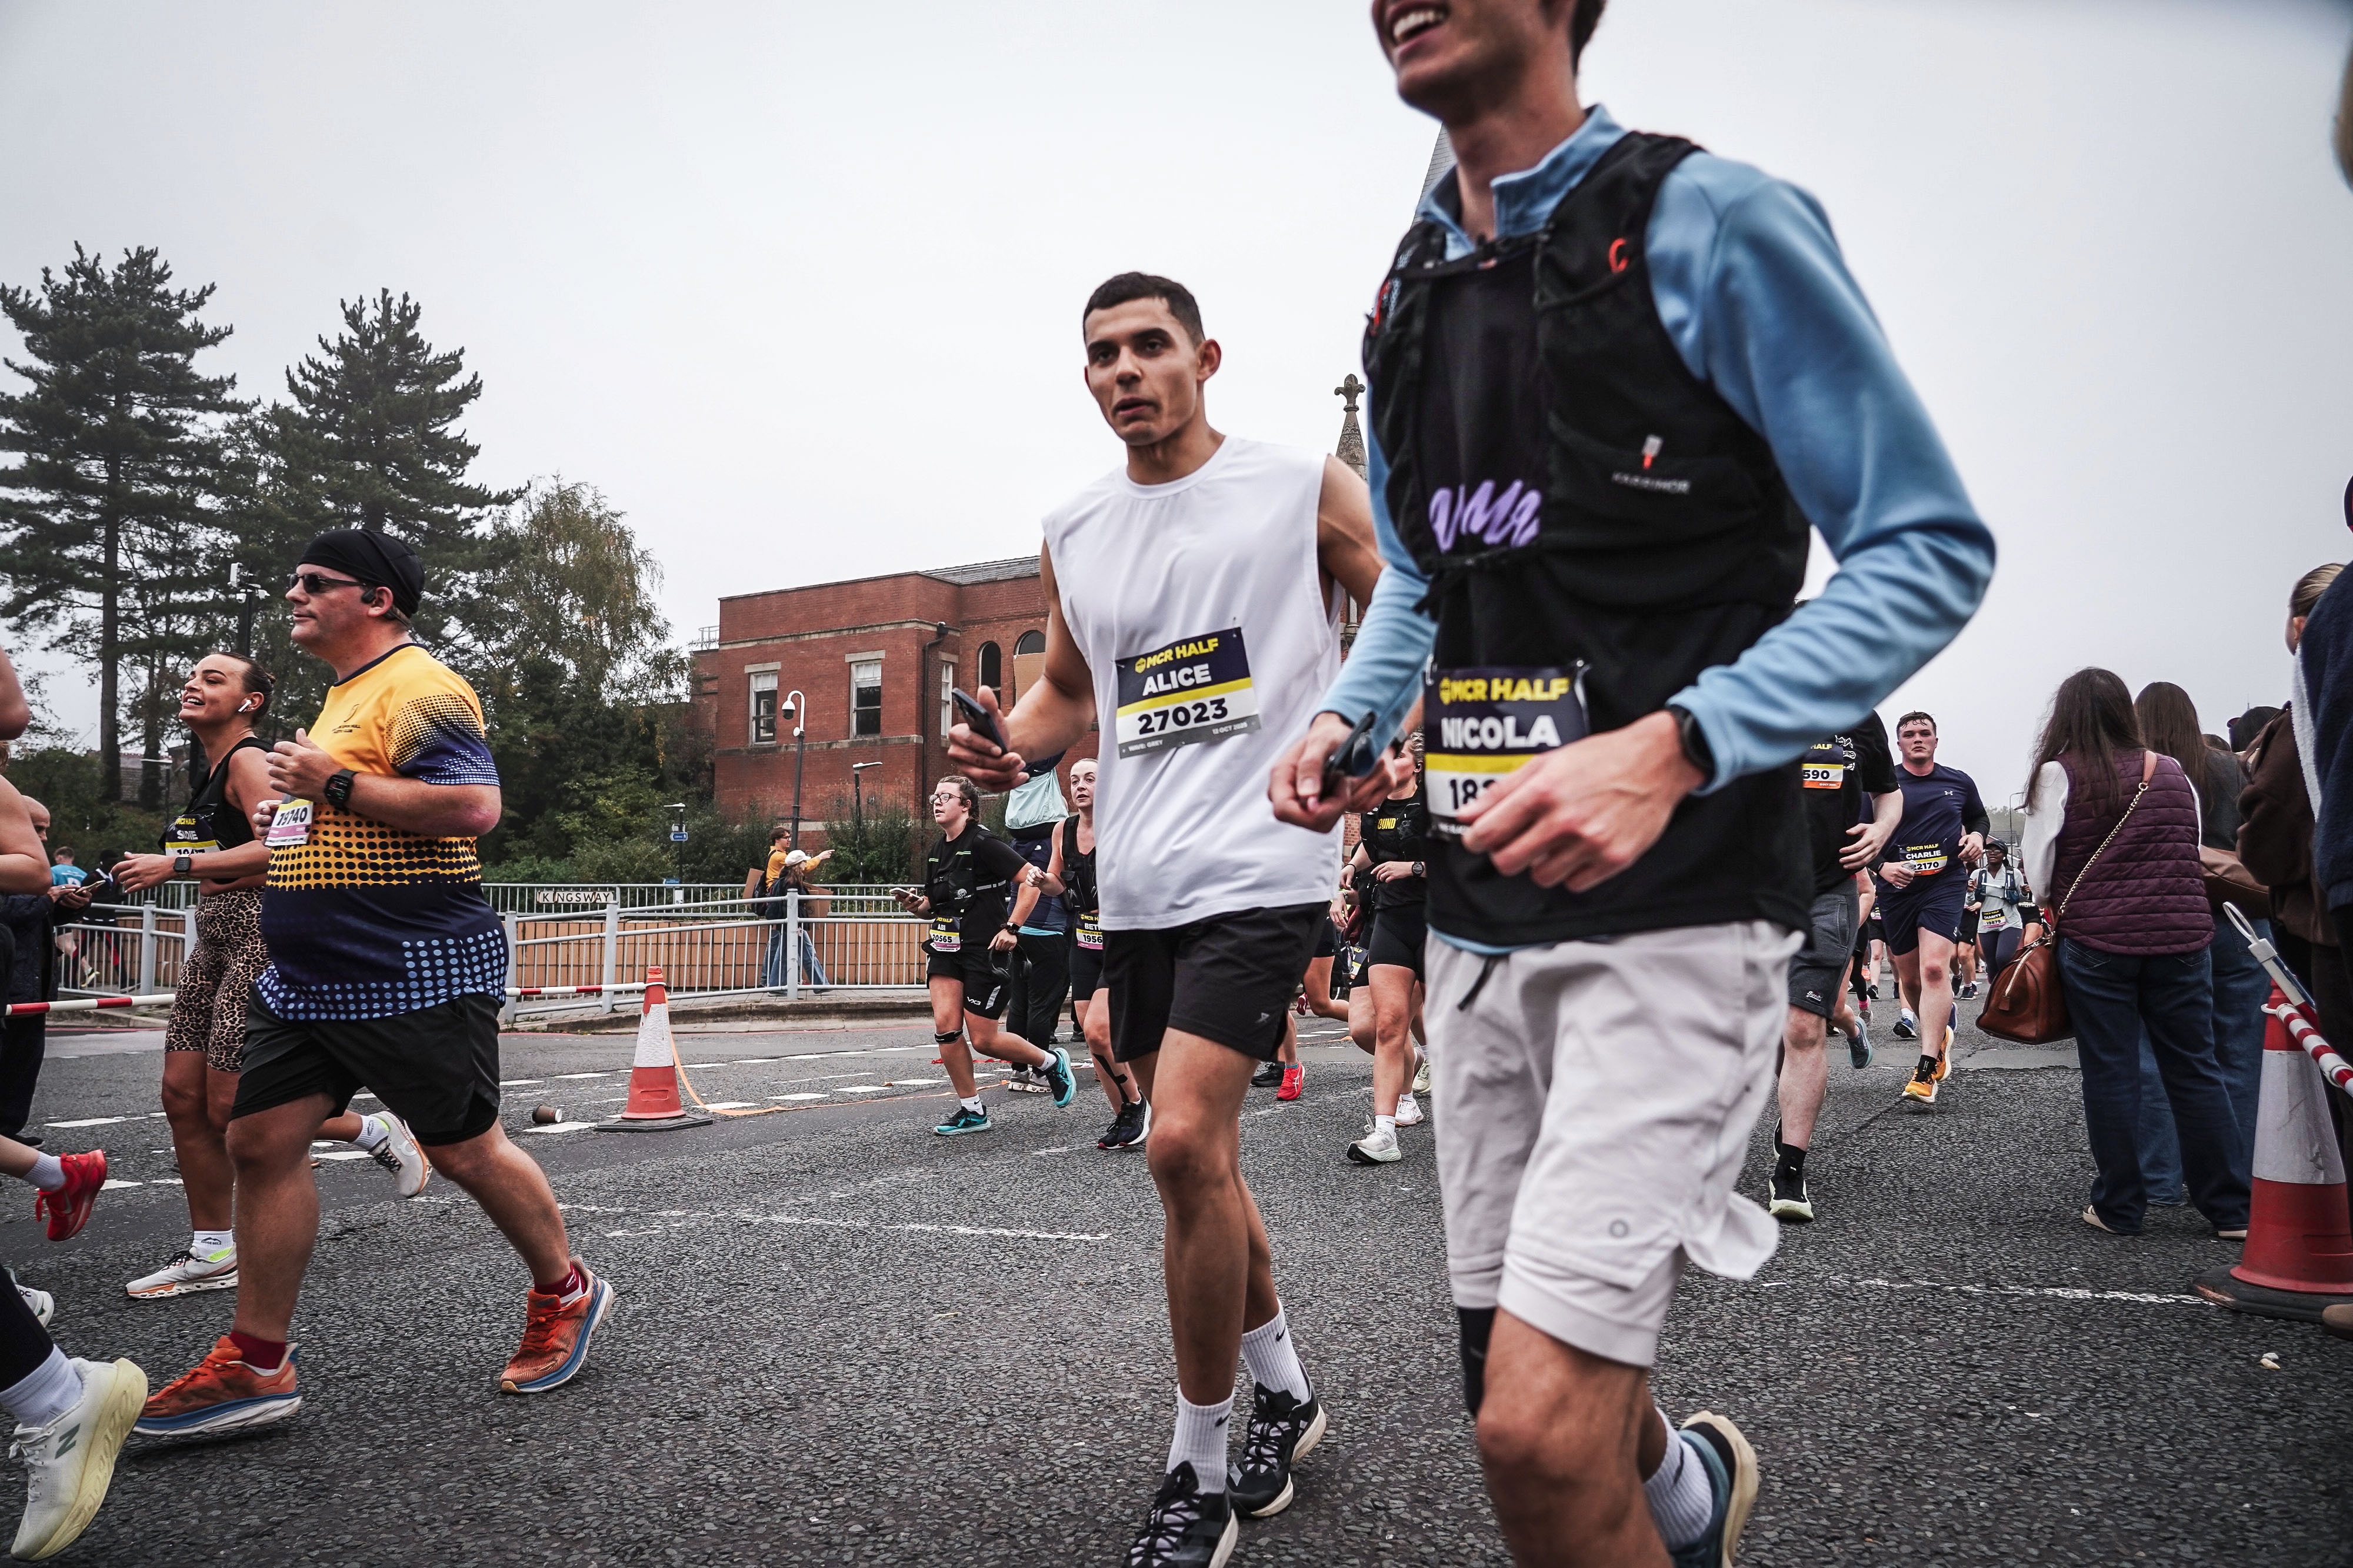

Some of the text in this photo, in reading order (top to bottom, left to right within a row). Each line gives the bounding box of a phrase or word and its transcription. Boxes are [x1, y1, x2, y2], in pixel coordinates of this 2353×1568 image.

[1146, 638, 1219, 669] MCR HALF
[1142, 663, 1212, 696] ALICE
[1449, 678, 1571, 701] MCR HALF
[1138, 698, 1228, 735] 27023
[1219, 725, 1232, 733] OCT
[1441, 715, 1562, 749] NICOLA
[276, 807, 308, 826] 19740
[1906, 850, 1941, 860] CHARLIE
[542, 893, 610, 902] KINGSWAY
[932, 934, 952, 943] 20565
